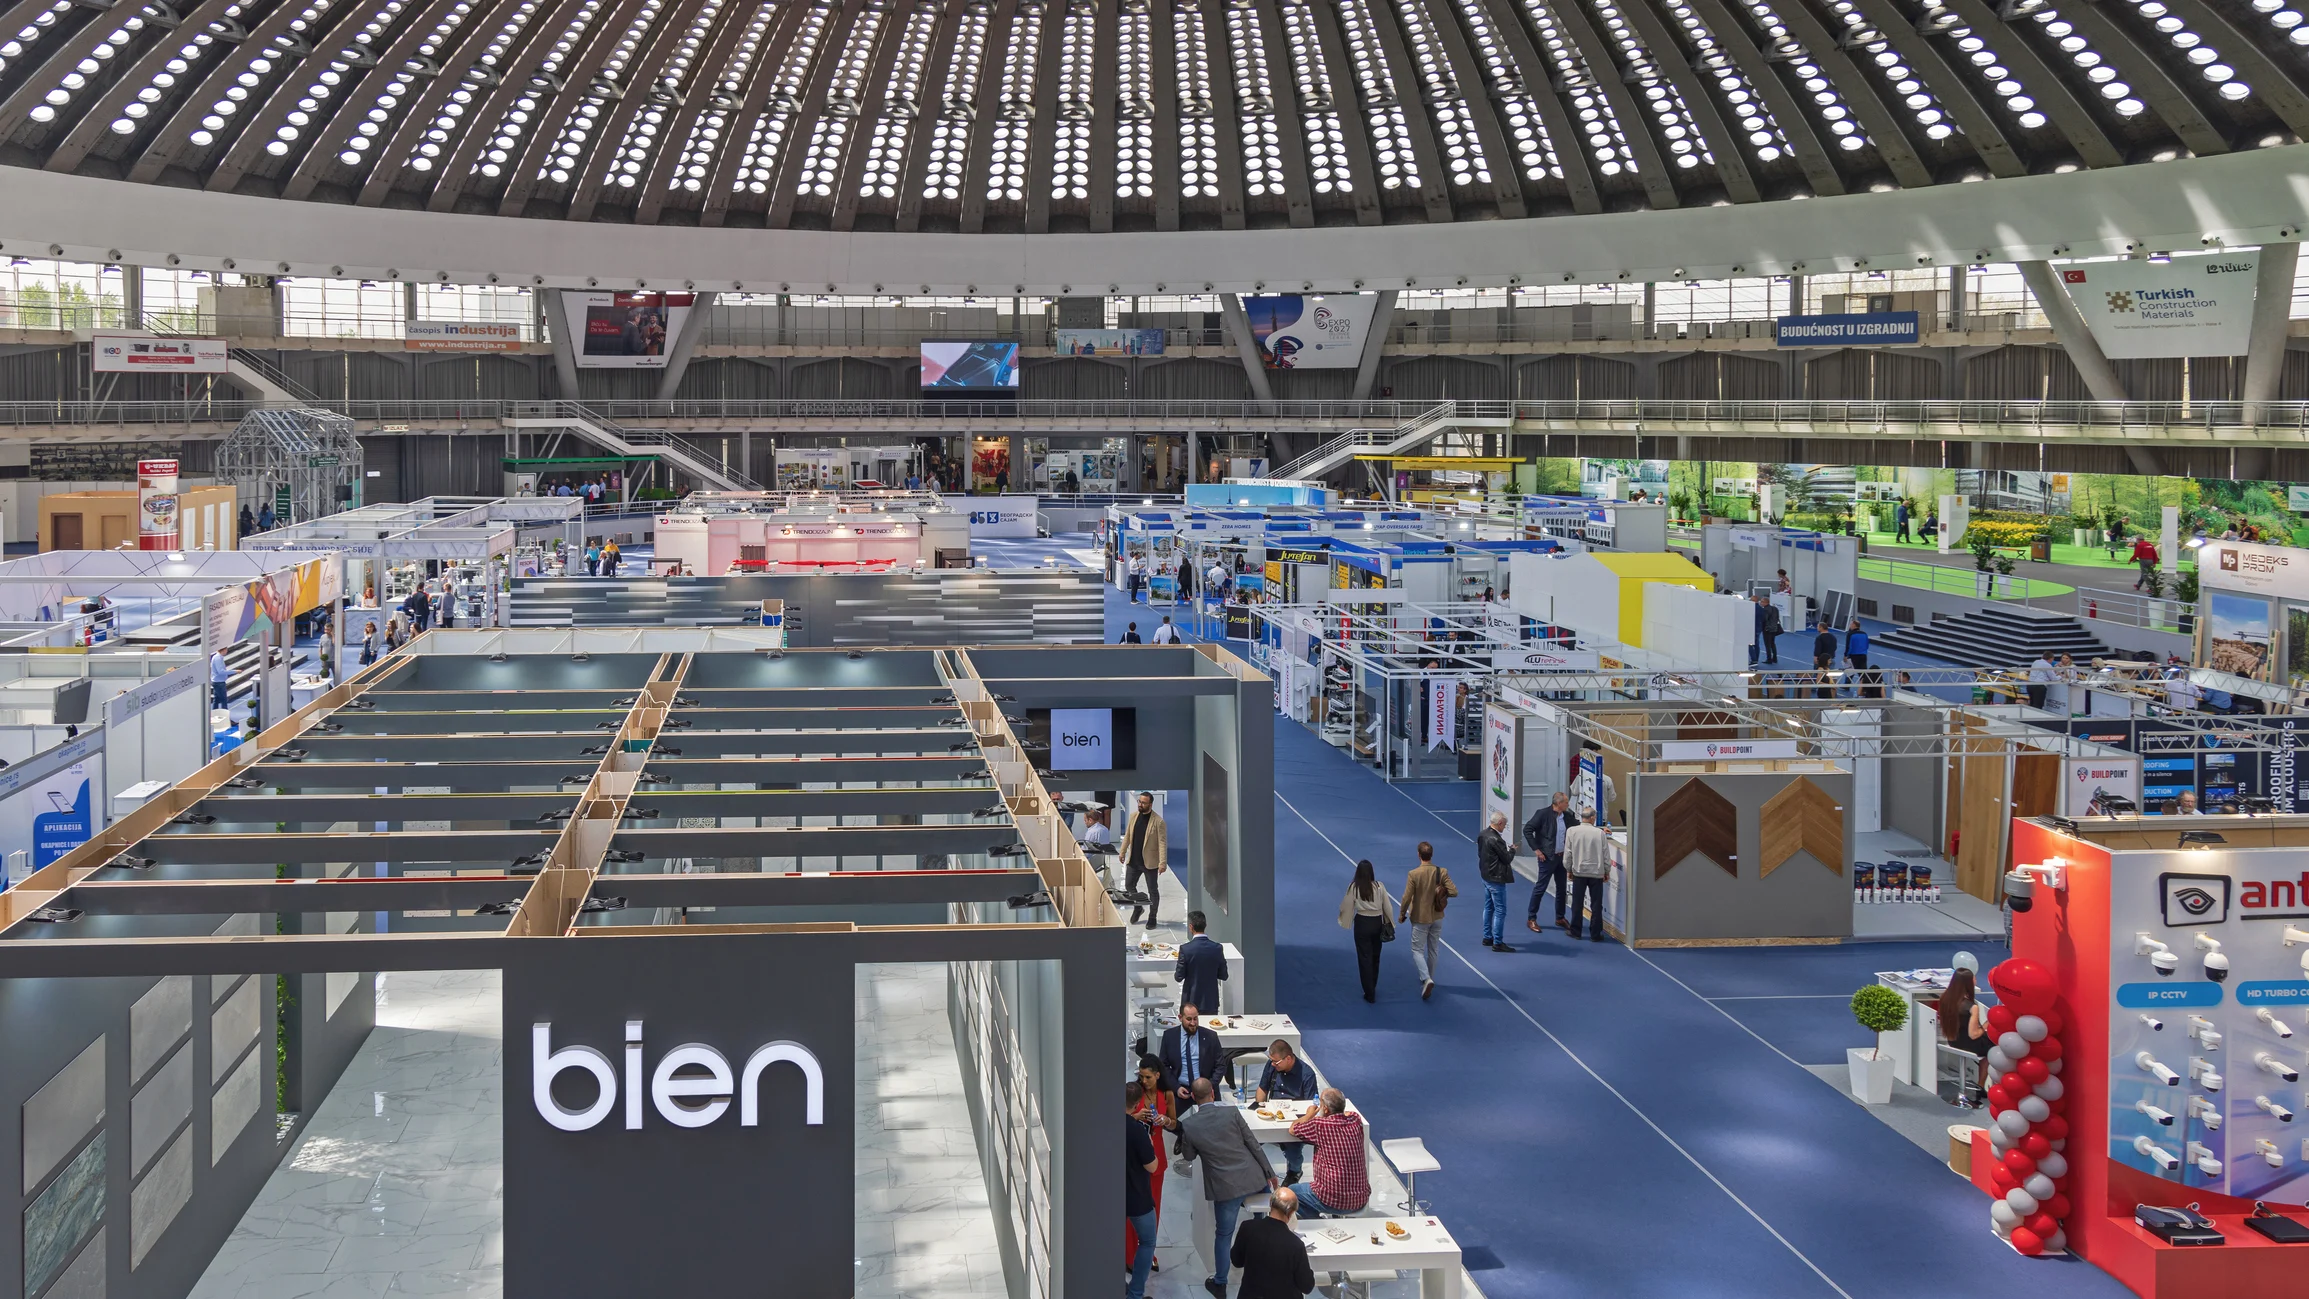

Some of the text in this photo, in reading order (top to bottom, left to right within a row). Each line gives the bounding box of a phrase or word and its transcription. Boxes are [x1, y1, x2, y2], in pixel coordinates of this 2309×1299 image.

[2135, 287, 2194, 301] Turkish
[2138, 298, 2217, 311] Construction
[2141, 309, 2194, 320] Materials
[1328, 318, 1351, 326] EXPO
[408, 324, 517, 338] časopis industrija
[1328, 325, 1351, 333] 2027
[1780, 322, 1914, 338] BUDUĆNOST U IZGRADNJI
[419, 341, 507, 350] www.industrija.rs
[2242, 553, 2289, 566] MEDEKS
[2242, 562, 2275, 574] PROM
[1523, 698, 1537, 710] BUILDPOINT
[1494, 719, 1512, 735] BUILDPOINT
[1062, 732, 1101, 747] bien
[1719, 746, 1753, 754] BUILDPOINT
[2091, 769, 2128, 779] BUILDPOINT
[44, 823, 83, 832] APLIKACIJA
[2148, 990, 2188, 1000] IP CCTV
[2247, 990, 2262, 998] HD
[2264, 989, 2298, 997] TURBO
[532, 1020, 824, 1131] bien
